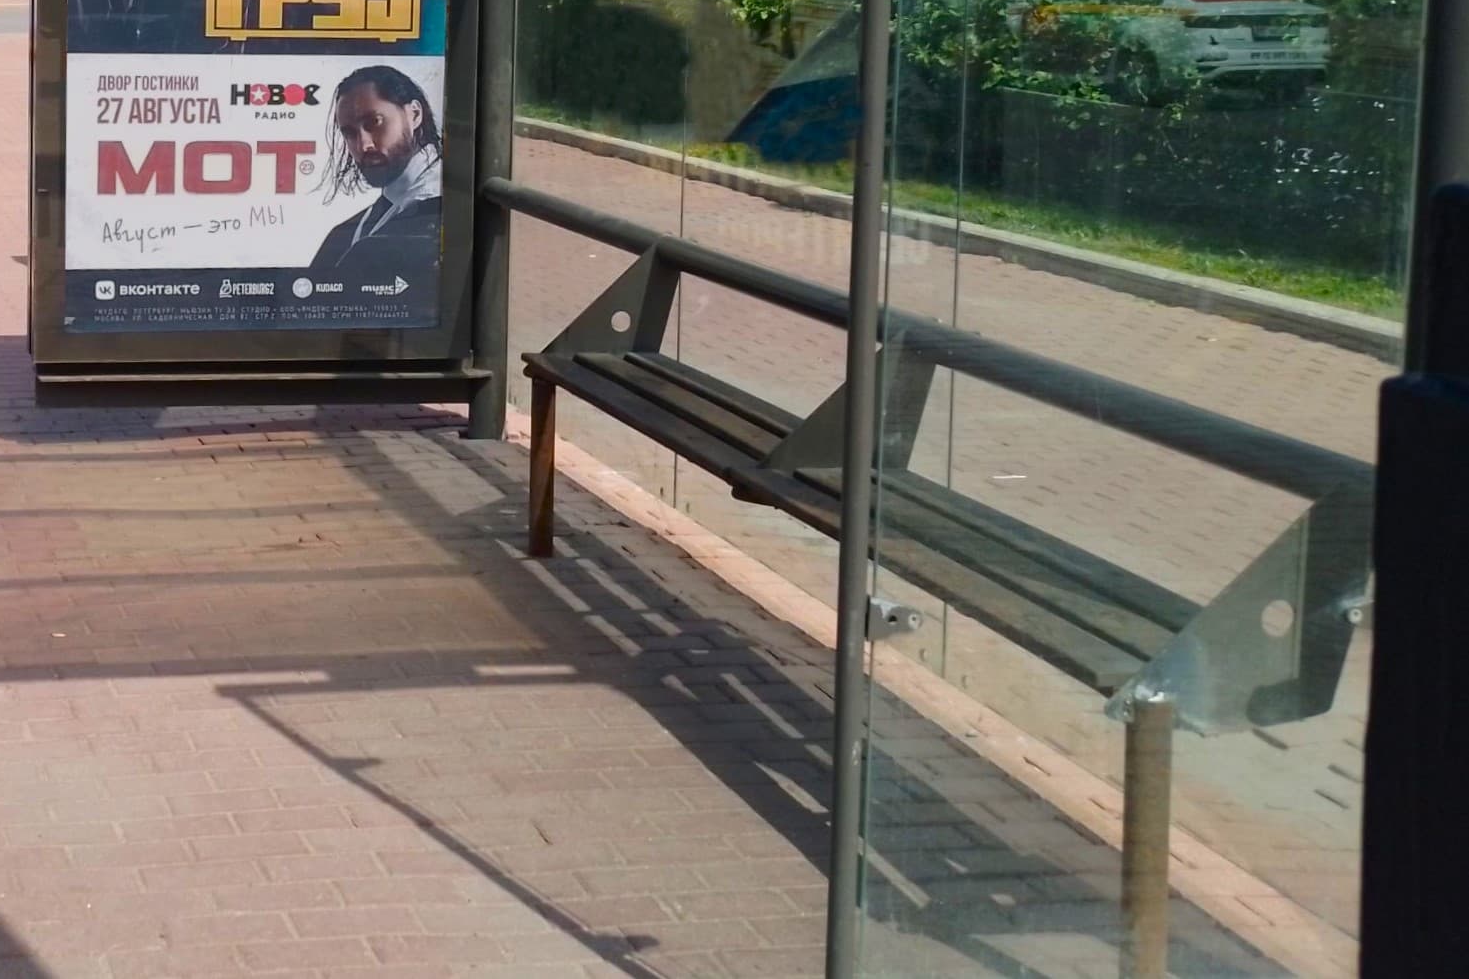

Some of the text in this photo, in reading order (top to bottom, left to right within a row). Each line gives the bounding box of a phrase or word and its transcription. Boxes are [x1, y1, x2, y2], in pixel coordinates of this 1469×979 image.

[96, 75, 199, 92] ДВОР ГОСТИНКИ
[96, 97, 221, 125] 27 АВГУСТА
[254, 111, 296, 120] РАДИО
[96, 140, 317, 196] МОТ
[102, 218, 176, 254] Август
[207, 218, 242, 234] это
[249, 205, 284, 228] МЫ
[119, 283, 201, 296] вконтакте
